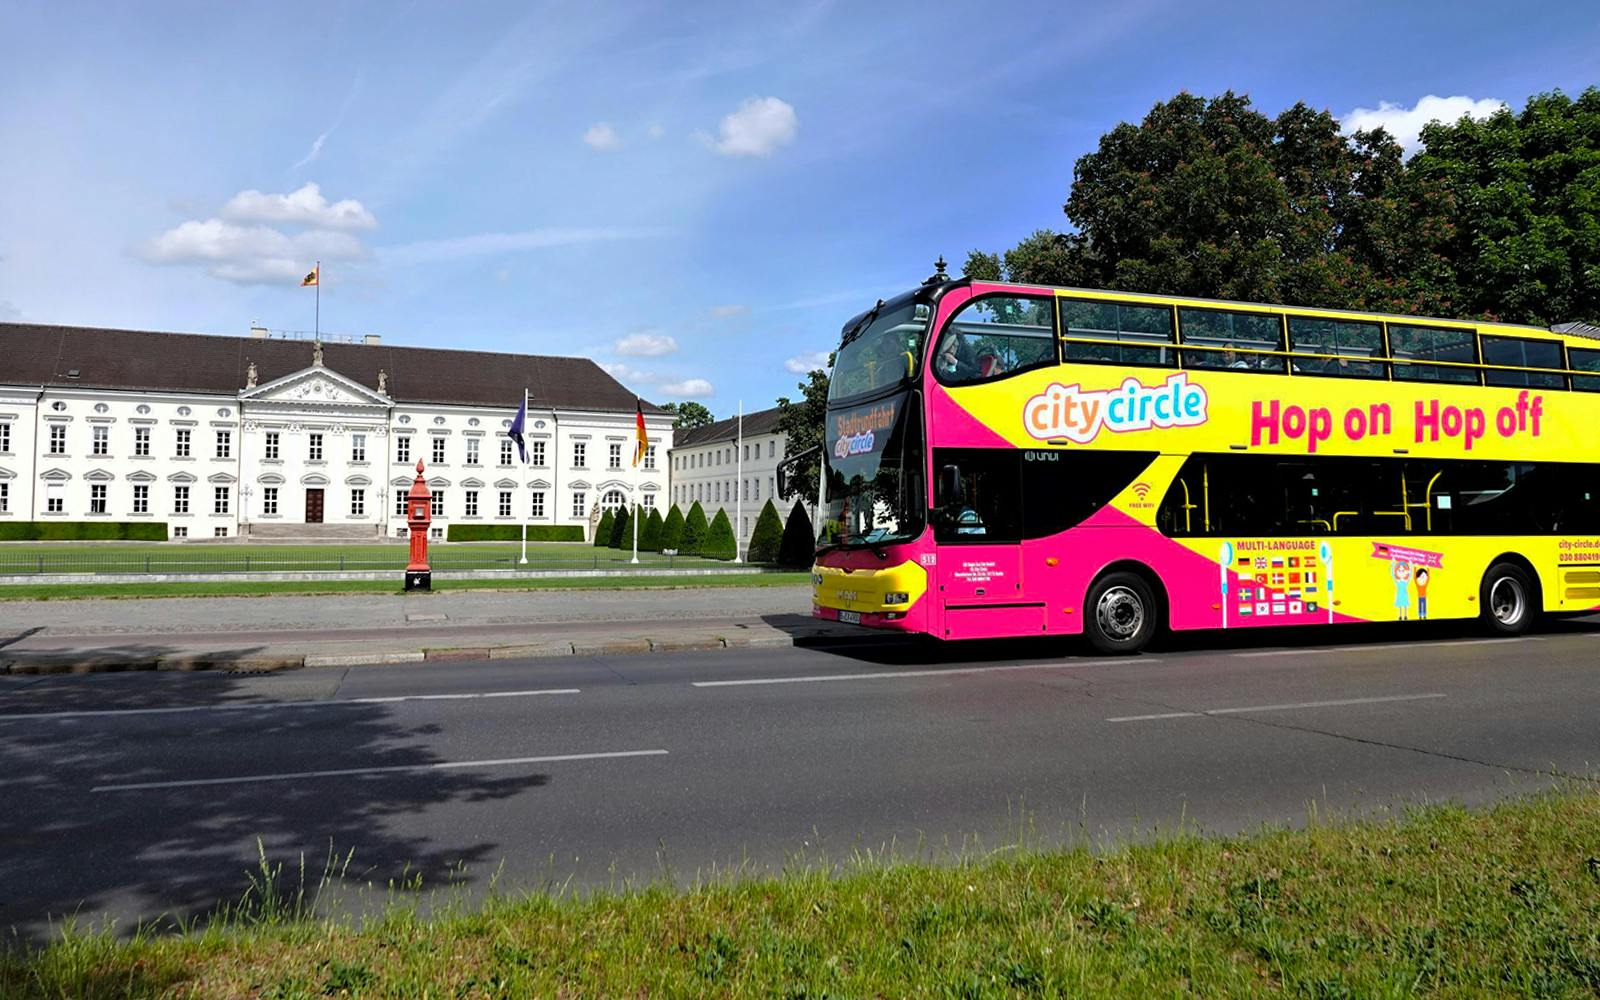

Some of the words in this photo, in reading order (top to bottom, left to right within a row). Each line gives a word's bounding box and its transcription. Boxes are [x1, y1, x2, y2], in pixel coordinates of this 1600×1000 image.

[837, 402, 895, 436] Stadtrundfahrt
[1031, 392, 1099, 435] city
[1108, 383, 1201, 424] circle
[1250, 399, 1333, 453] Hop
[1343, 402, 1392, 441] on
[1414, 399, 1486, 450] Hop
[1496, 390, 1543, 438] off
[836, 435, 849, 457] city
[849, 431, 873, 453] circle
[1237, 541, 1316, 551] MULTI-LANGUAGE
[1559, 539, 1600, 550] city-circle.d
[1559, 553, 1572, 561] 030
[1574, 553, 1600, 561] 880419
